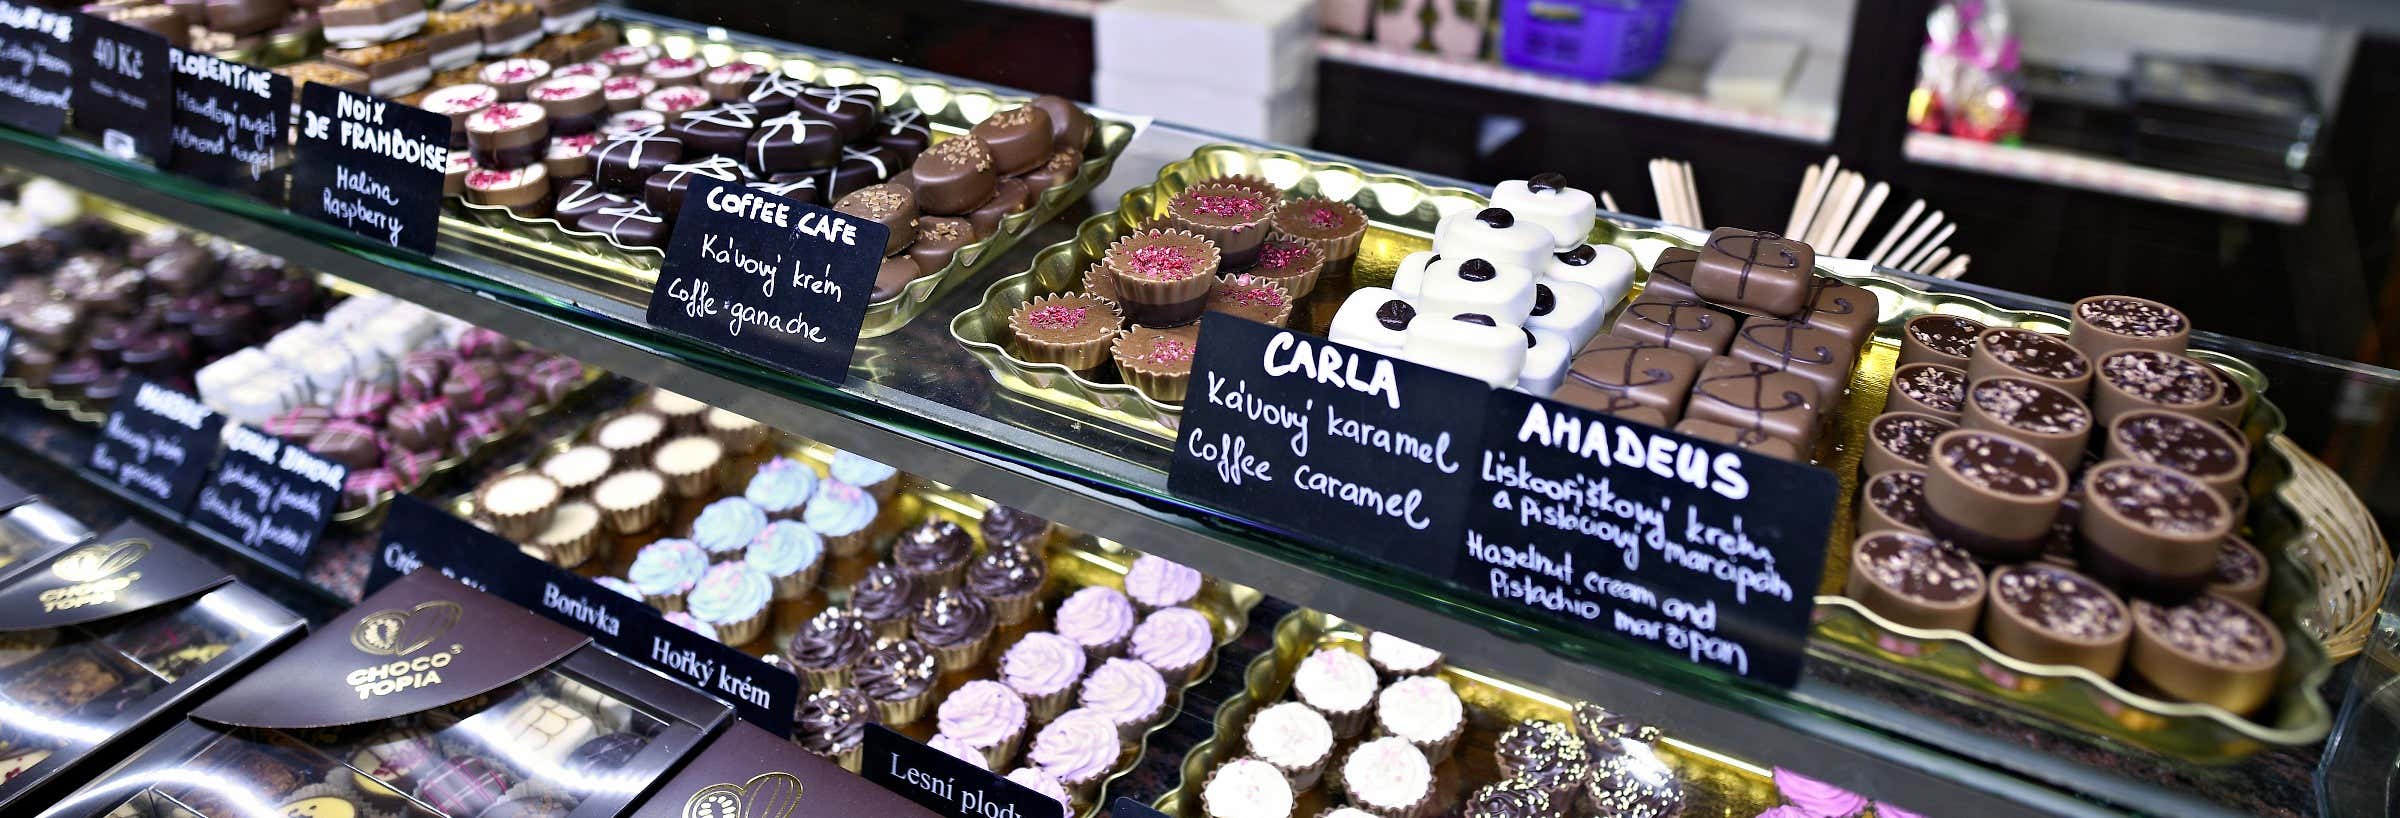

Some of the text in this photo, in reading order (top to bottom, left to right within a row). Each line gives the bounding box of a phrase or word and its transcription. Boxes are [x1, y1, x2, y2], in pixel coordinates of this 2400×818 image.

[93, 37, 115, 69] 40
[168, 48, 272, 99] FLORENTINE
[304, 110, 447, 173] DE FRAMBOISE
[337, 164, 399, 207] Halina
[322, 187, 403, 248] Raspberry
[706, 186, 857, 246] COFFEE CAFE
[701, 233, 842, 302] Kávový krém
[729, 302, 827, 343] ganache
[1263, 331, 1401, 409] CARLA
[1207, 370, 1460, 474] Kávový karamel
[1518, 402, 1749, 500] AMADEUS
[1187, 427, 1273, 485] Coffee
[1492, 490, 1513, 510] a
[1583, 571, 1657, 610] cream
[1662, 598, 1716, 632] and
[346, 652, 452, 686] CHOCO
[354, 670, 442, 700] TOPIA
[652, 636, 771, 710] Hořký krém
[890, 752, 955, 801] Lesní
